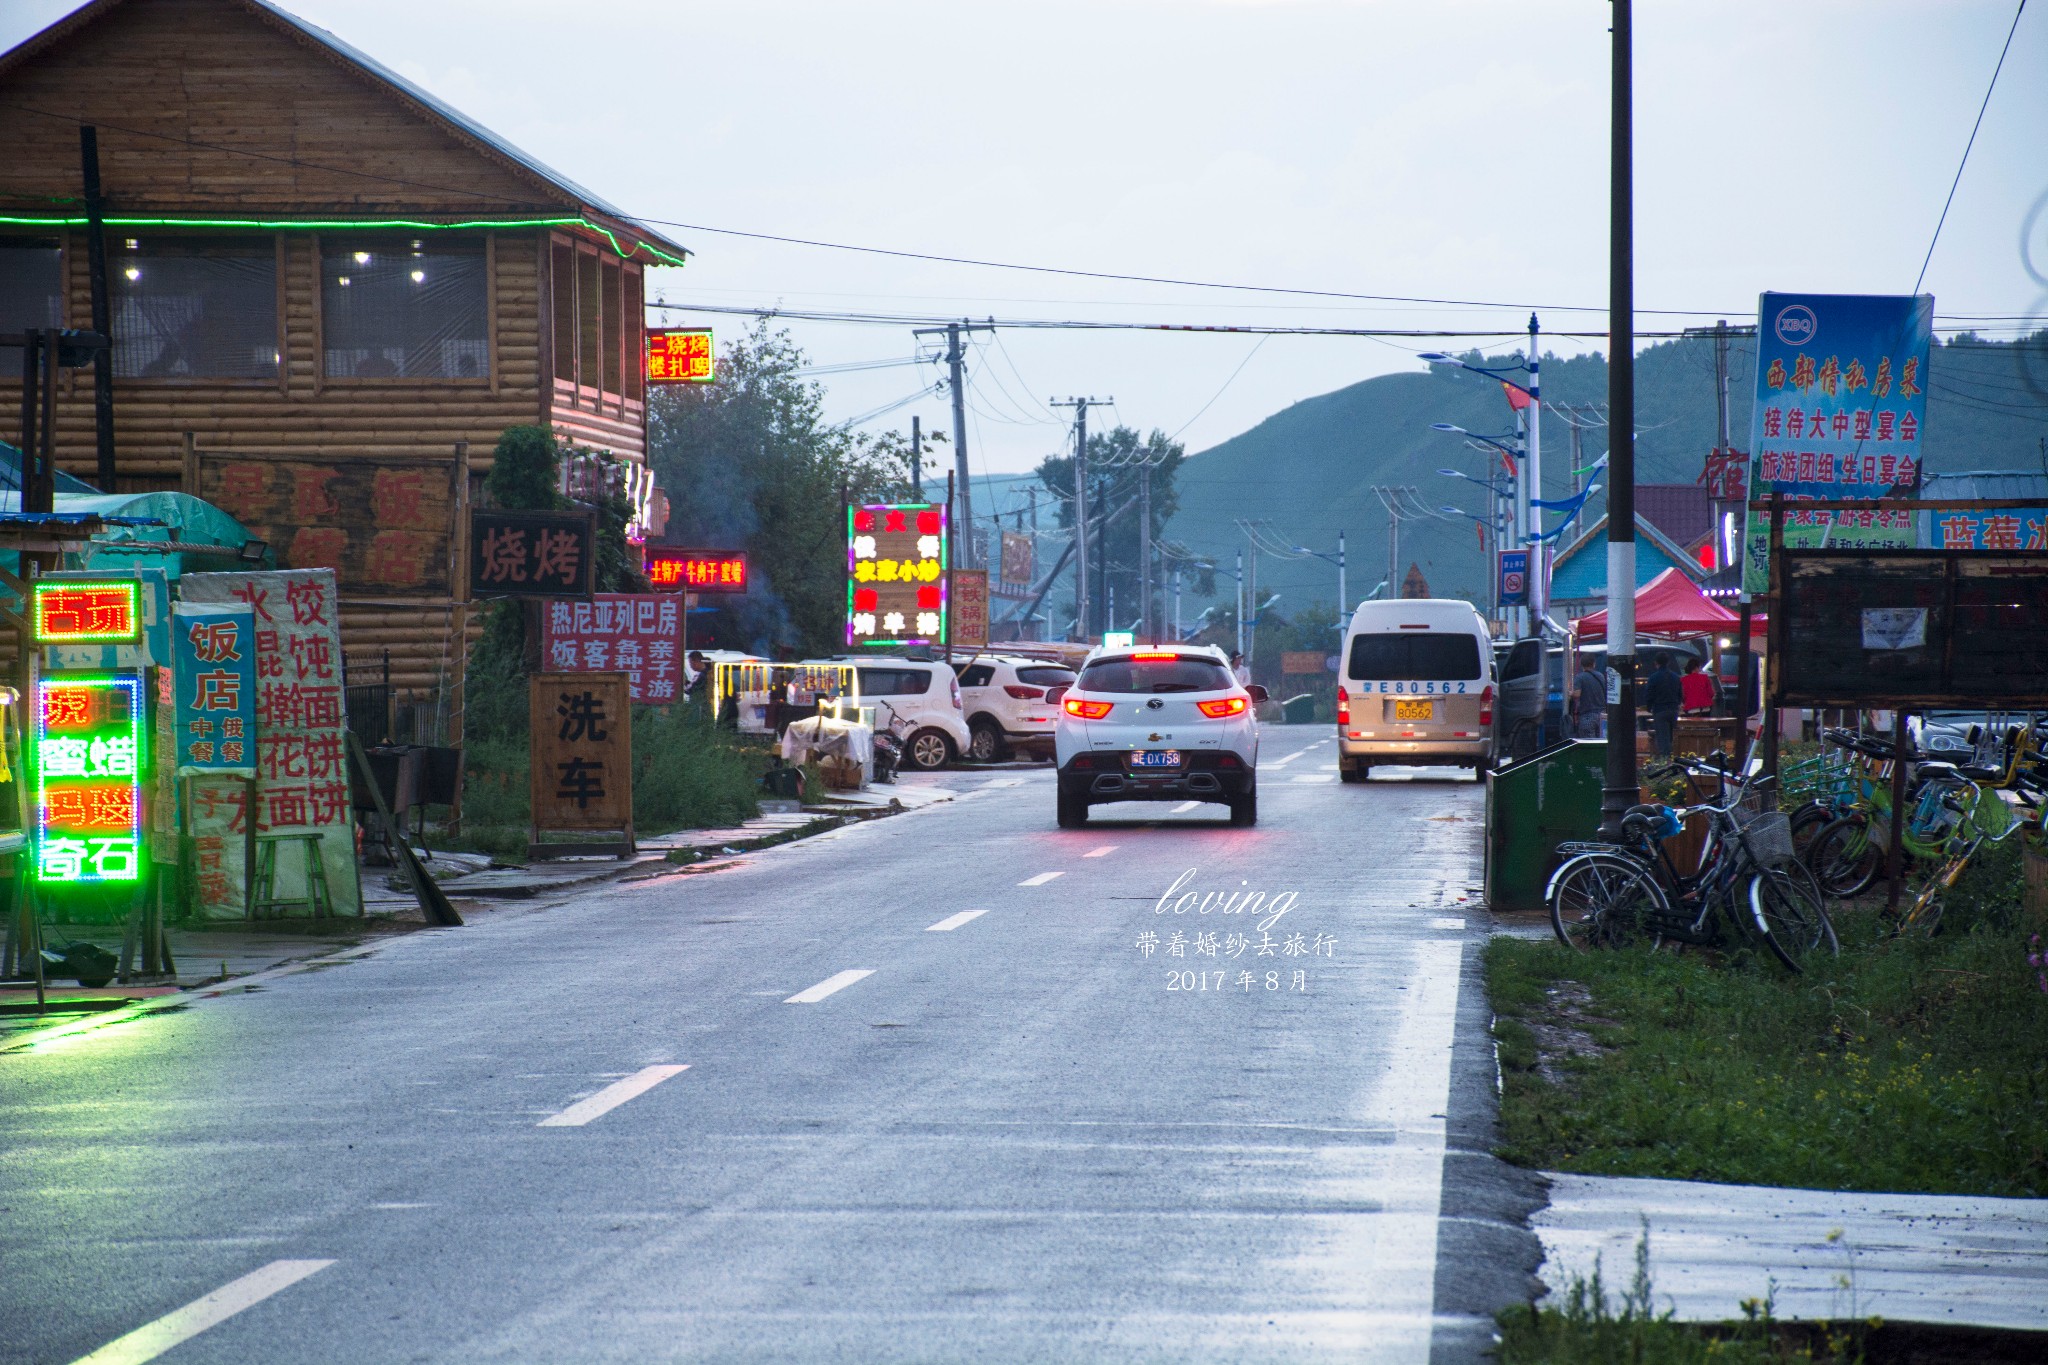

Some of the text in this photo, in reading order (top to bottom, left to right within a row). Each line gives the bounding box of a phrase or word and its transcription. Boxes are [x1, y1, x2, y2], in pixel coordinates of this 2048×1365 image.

[666, 335, 709, 356] 烧烤
[1781, 318, 1811, 333] XBQ
[667, 357, 710, 377] 扎啤
[1767, 352, 1921, 400] 西部情私房菜
[1764, 407, 1919, 442] 接待大中型宴会
[1760, 450, 1917, 486] 旅游团组 生日宴会
[480, 525, 581, 585] 烧烤
[651, 560, 682, 582] 土特产
[686, 560, 717, 583] 牛肉干
[853, 559, 941, 583] 农家小炒
[40, 589, 131, 635] 古玩
[231, 579, 328, 626] 水饺
[551, 600, 677, 636] 热尼亚列巴房
[190, 621, 243, 711] 饭店
[551, 638, 578, 672] 饭
[583, 639, 609, 672] 客
[648, 639, 675, 698] 亲子游
[255, 682, 341, 729] 擀面
[1398, 708, 1431, 719] 80562
[189, 717, 214, 763] 中餐
[221, 717, 244, 763] 俄餐
[227, 732, 345, 783] 花饼
[557, 692, 607, 808] 洗车
[44, 788, 132, 826] 玛瑙
[227, 780, 349, 834] 发面饼
[43, 837, 132, 879] 奇石
